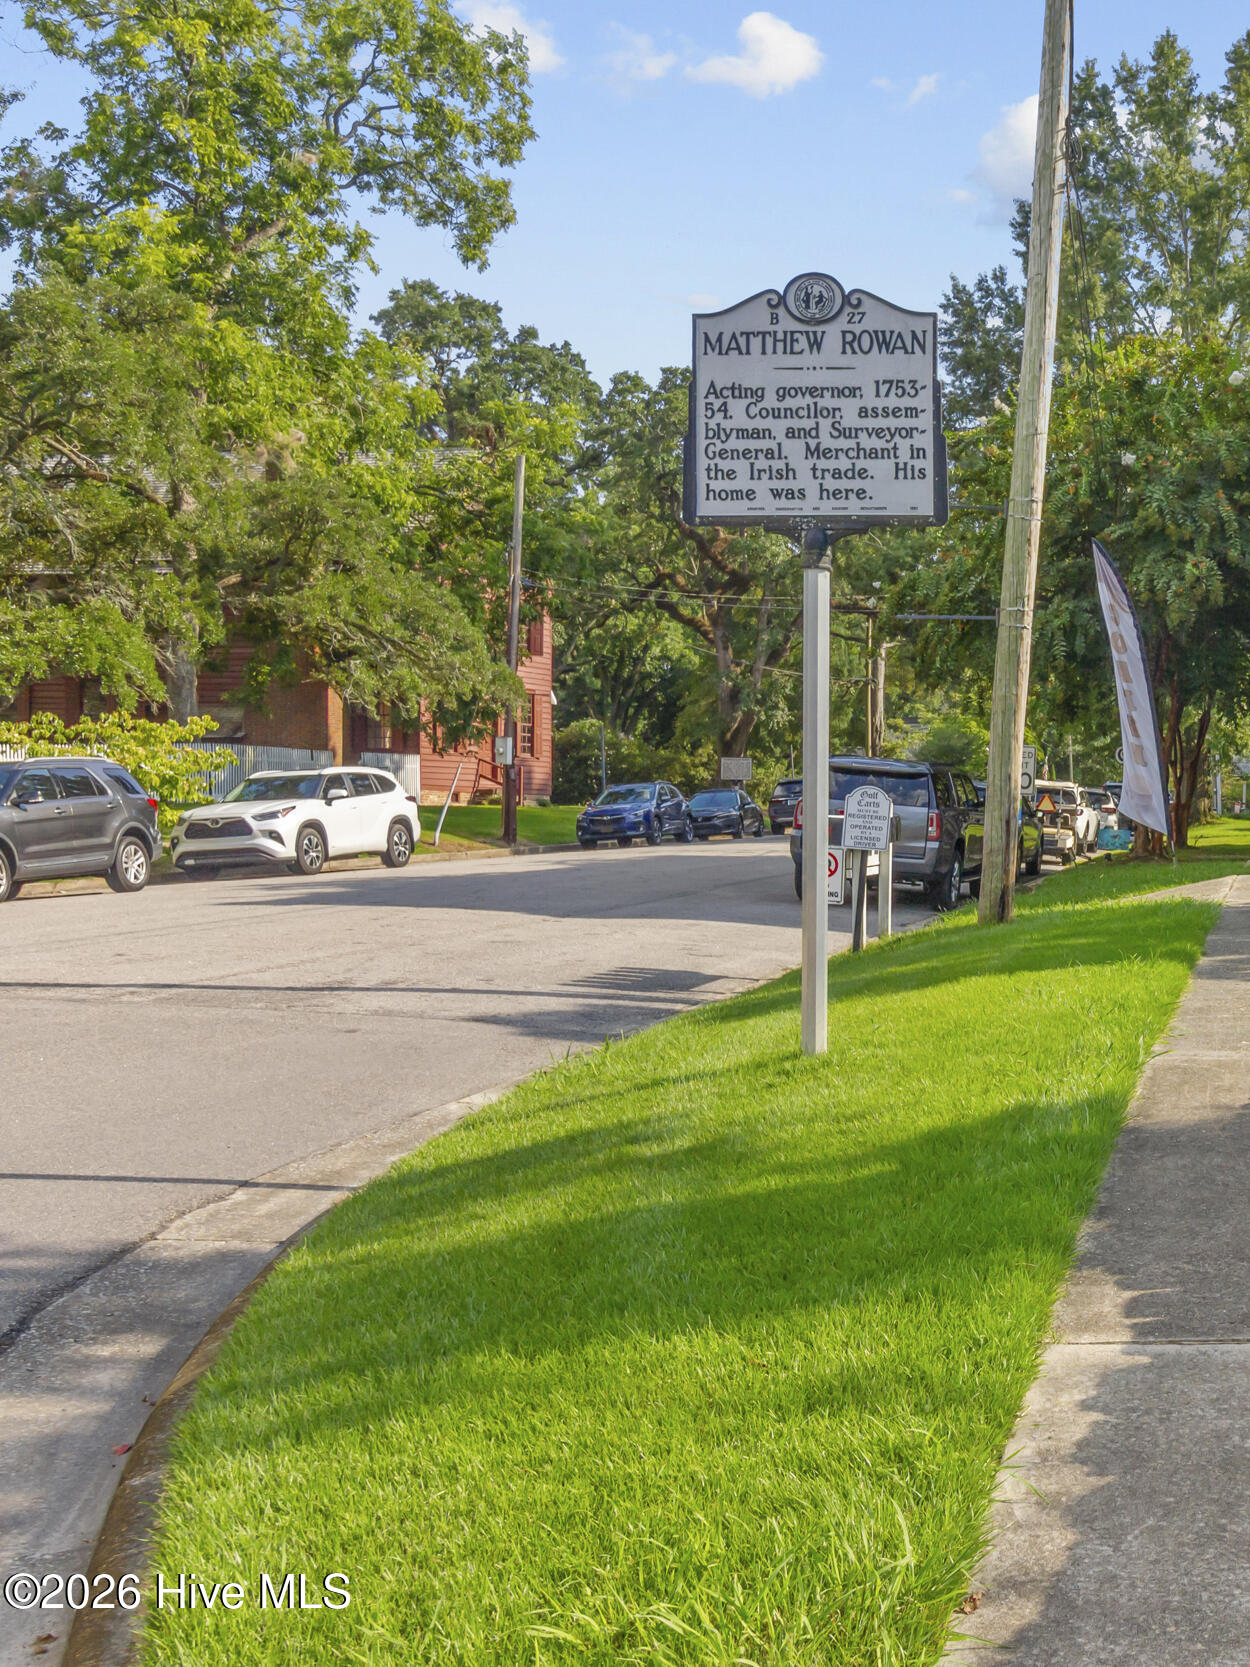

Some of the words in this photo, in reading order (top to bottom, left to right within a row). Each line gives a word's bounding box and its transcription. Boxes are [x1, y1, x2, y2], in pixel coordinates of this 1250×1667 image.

[769, 312, 780, 325] B
[846, 311, 866, 324] 27
[702, 330, 826, 356] MATTHEW
[840, 329, 928, 355] ROWAN
[703, 380, 766, 402] Acting
[775, 385, 864, 402] governor,
[873, 379, 928, 398] 1753-
[704, 401, 733, 420] 54.
[745, 401, 844, 420] Councilor,
[857, 405, 927, 419] assem-
[704, 422, 777, 444] blyman,
[784, 421, 820, 440] and
[829, 420, 928, 443] Surveyor-
[704, 442, 788, 460] General.
[804, 441, 900, 460] Merchant
[909, 444, 927, 460] in
[704, 463, 738, 480] the
[749, 462, 798, 480] Irish
[810, 462, 875, 480] trade.
[893, 461, 927, 480] His
[704, 483, 758, 501] home
[768, 488, 807, 501] was
[818, 483, 873, 501] here.
[857, 799, 880, 808] Carts
[860, 790, 879, 800] Golf
[847, 813, 887, 821] REGISTERED
